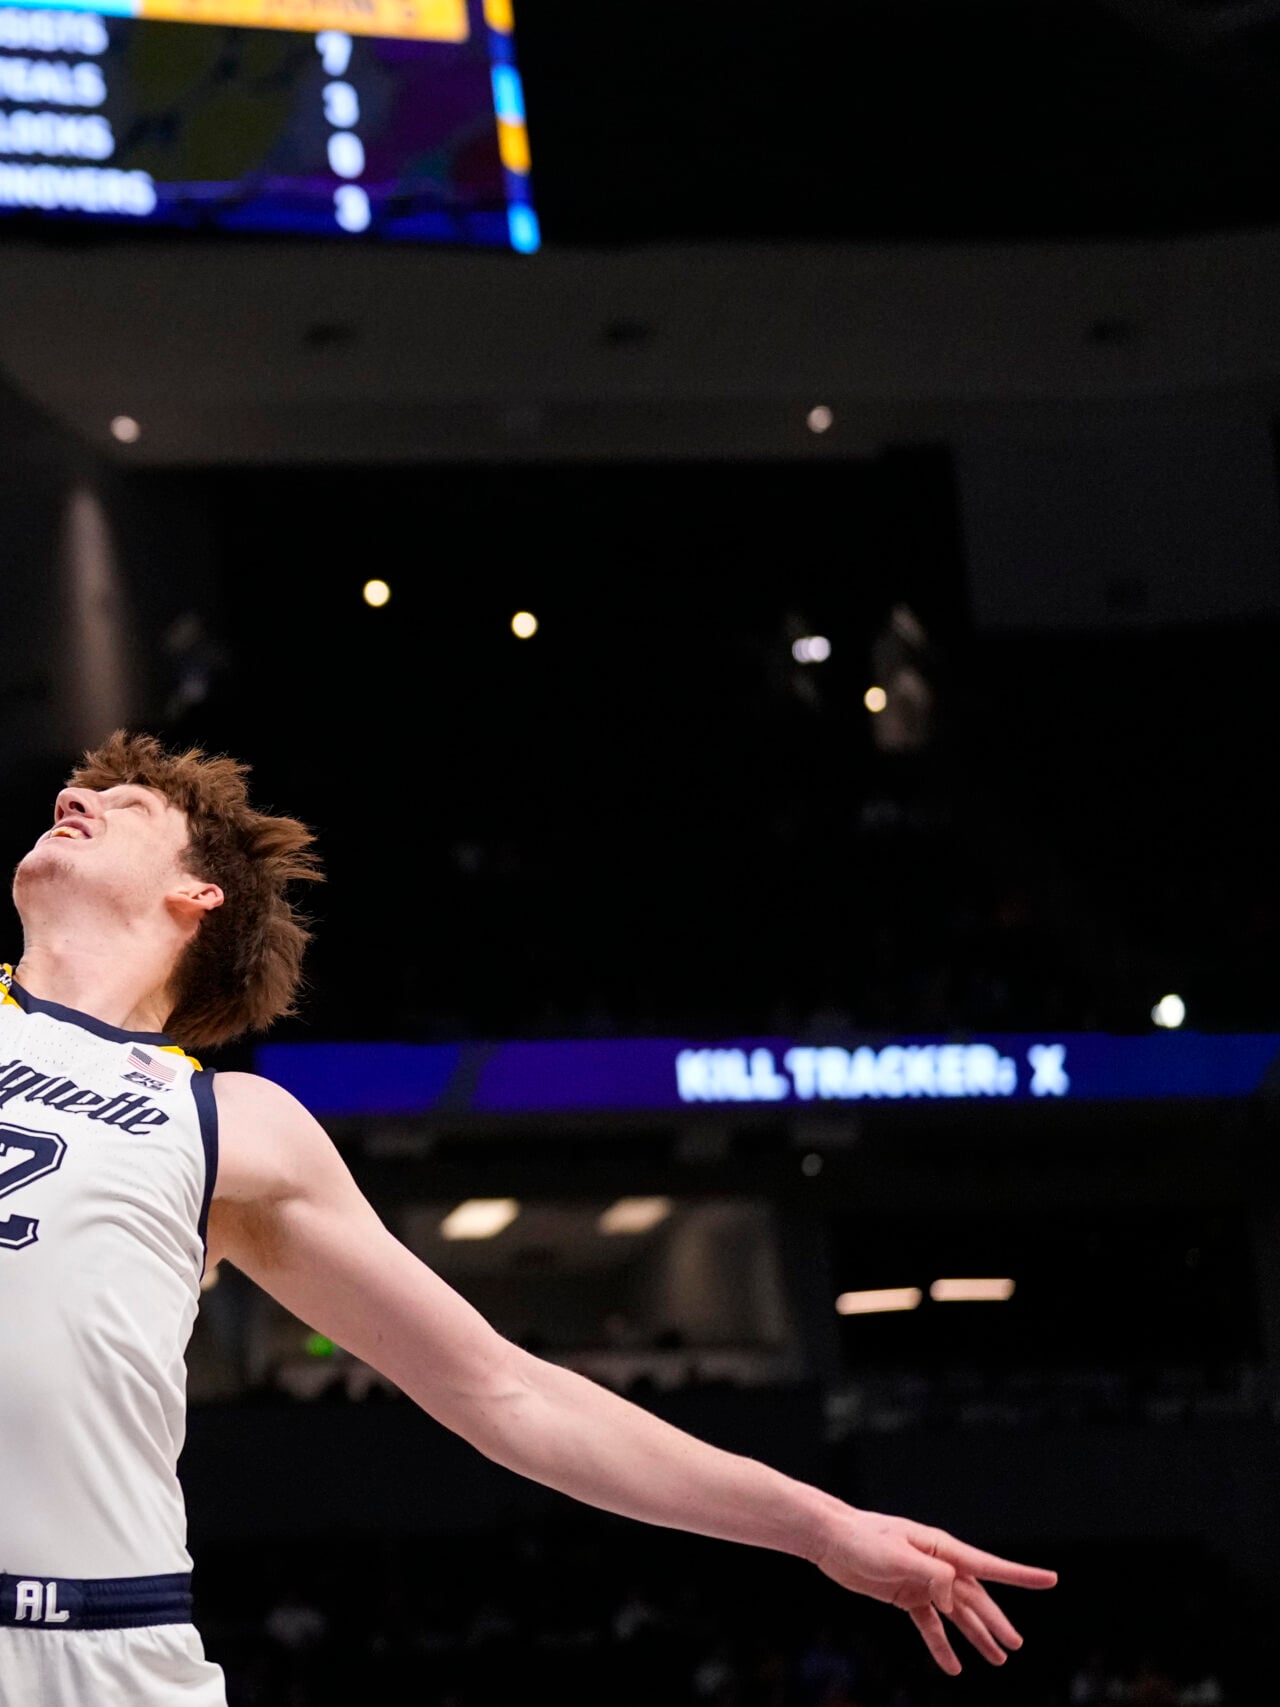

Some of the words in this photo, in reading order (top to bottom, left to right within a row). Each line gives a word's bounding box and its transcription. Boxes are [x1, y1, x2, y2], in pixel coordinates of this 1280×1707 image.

[677, 1048, 788, 1101] KILL
[784, 1044, 1017, 1099] TRACKER:
[1028, 1044, 1069, 1096] X
[15, 1580, 70, 1623] AL
